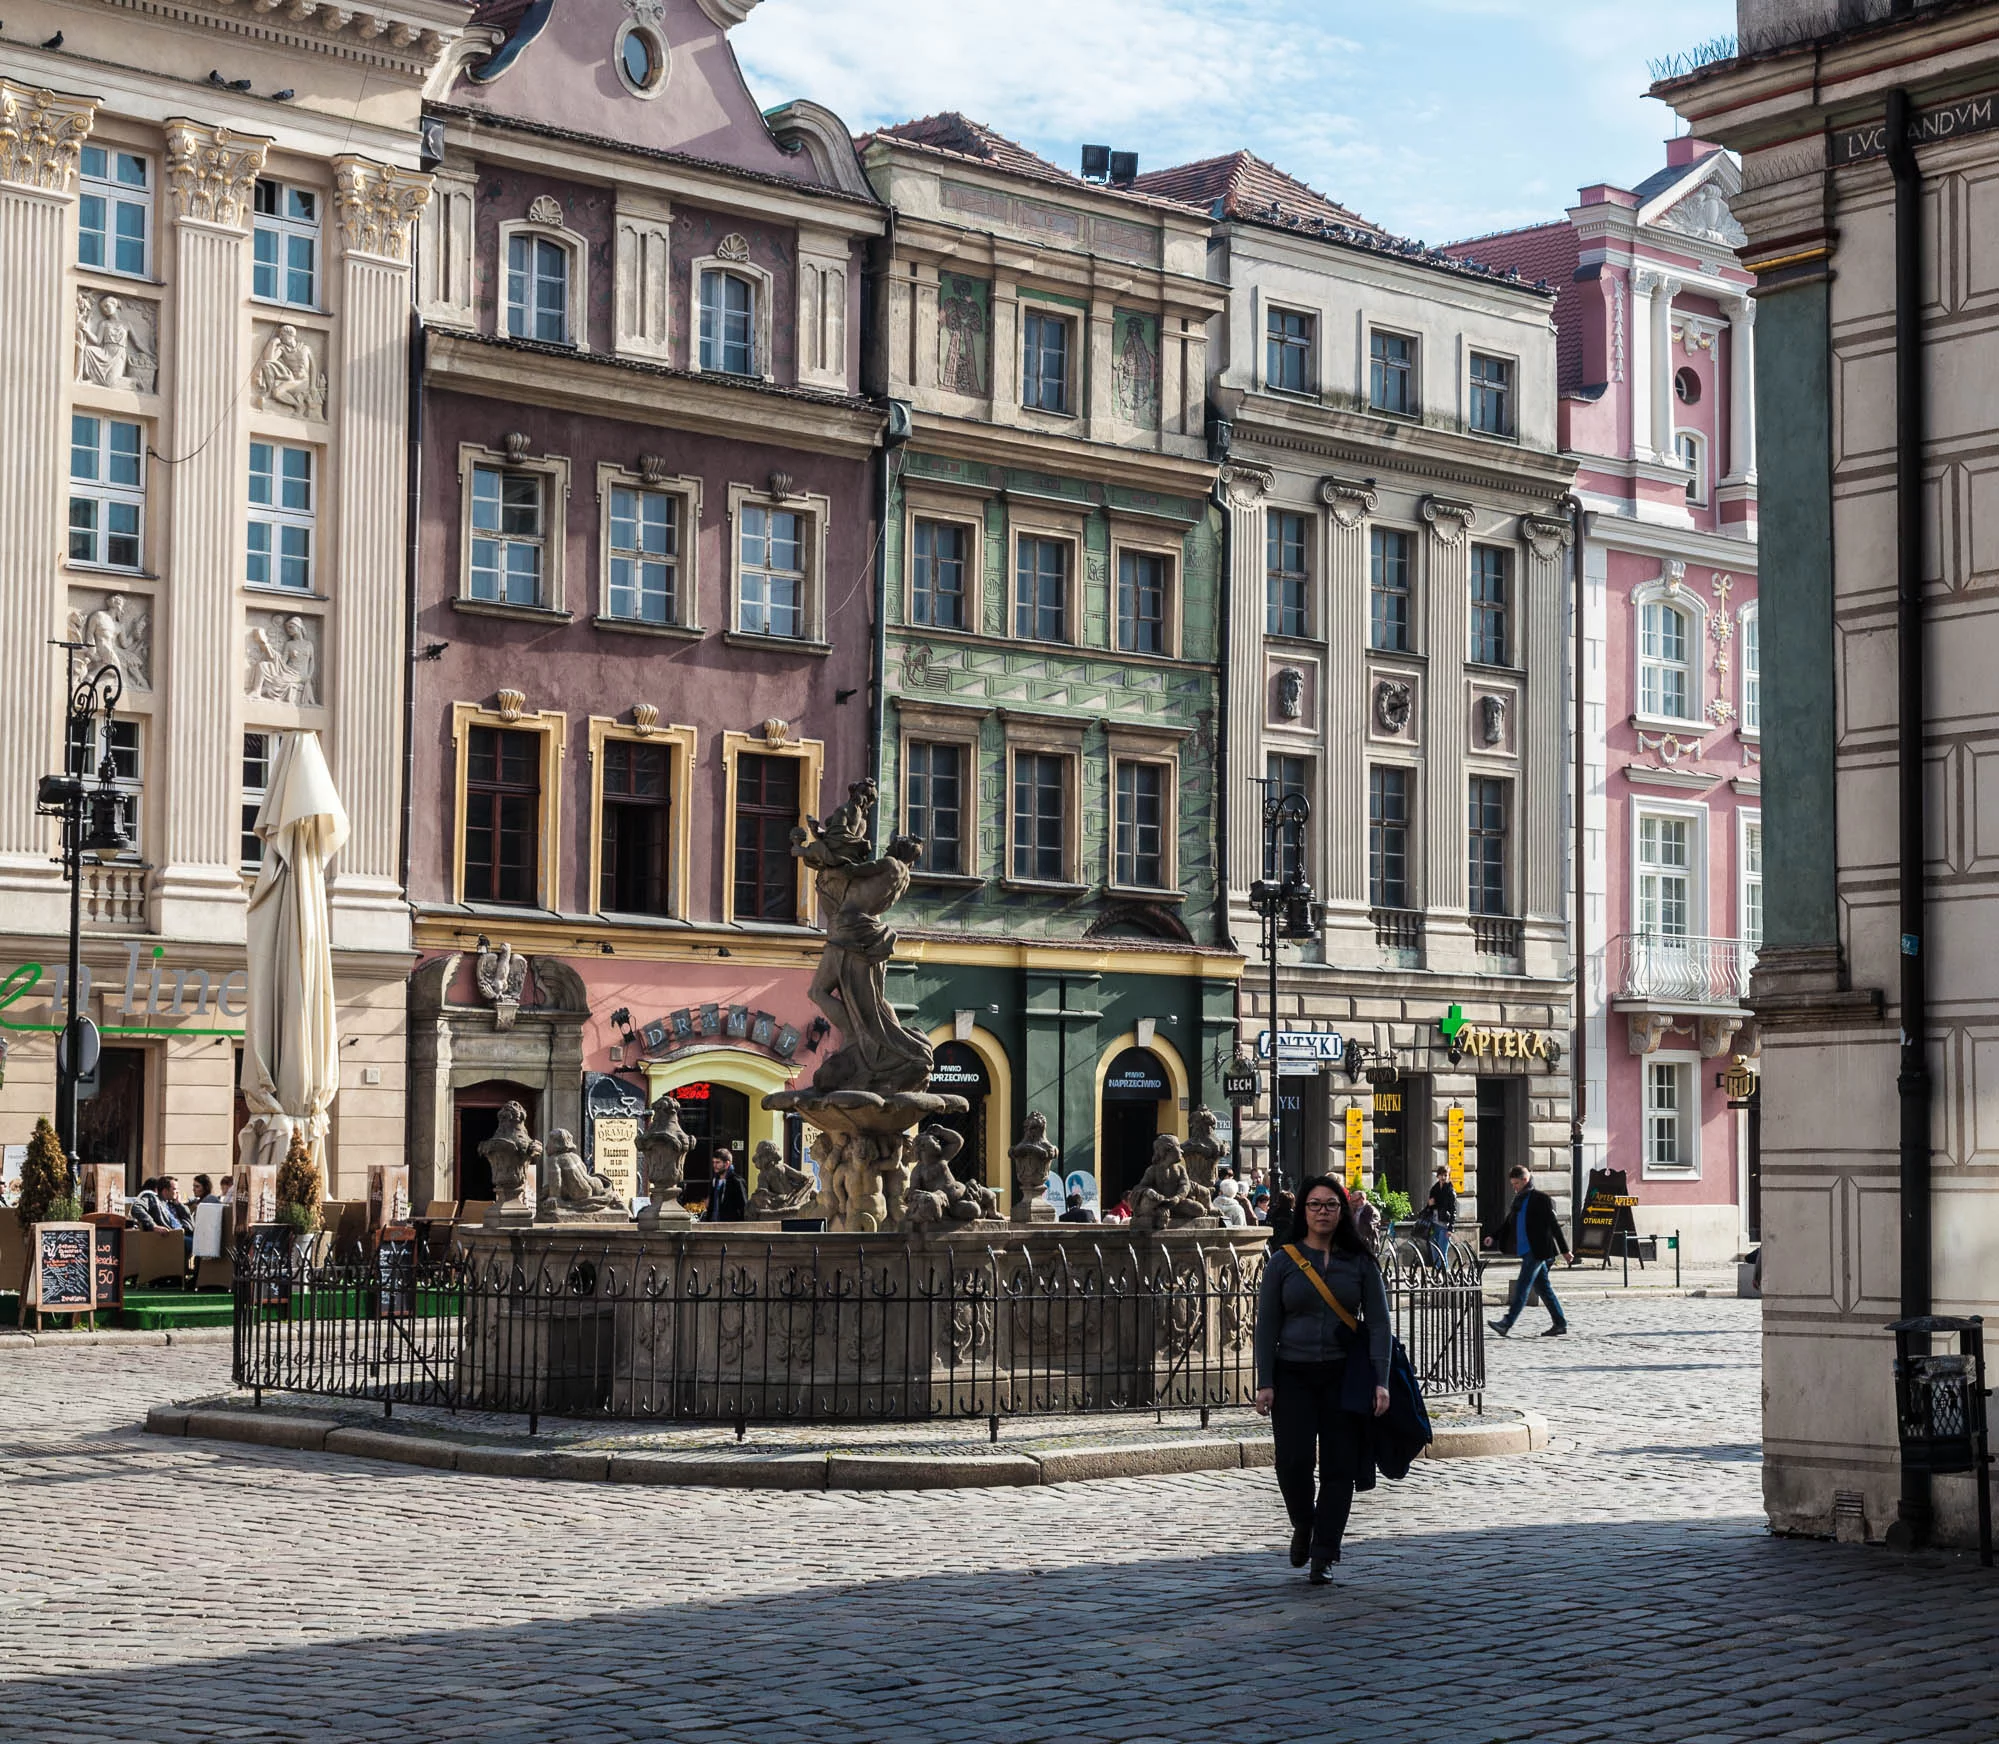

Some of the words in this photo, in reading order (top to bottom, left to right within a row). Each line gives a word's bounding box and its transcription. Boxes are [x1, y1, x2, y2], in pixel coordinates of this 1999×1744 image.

[648, 1012, 797, 1047] DRAMAT
[1453, 1022, 1547, 1060] APTEKA
[1227, 1078, 1253, 1091] LECH
[1614, 1196, 1638, 1207] APTEKA
[1583, 1217, 1613, 1225] OTWARTE
